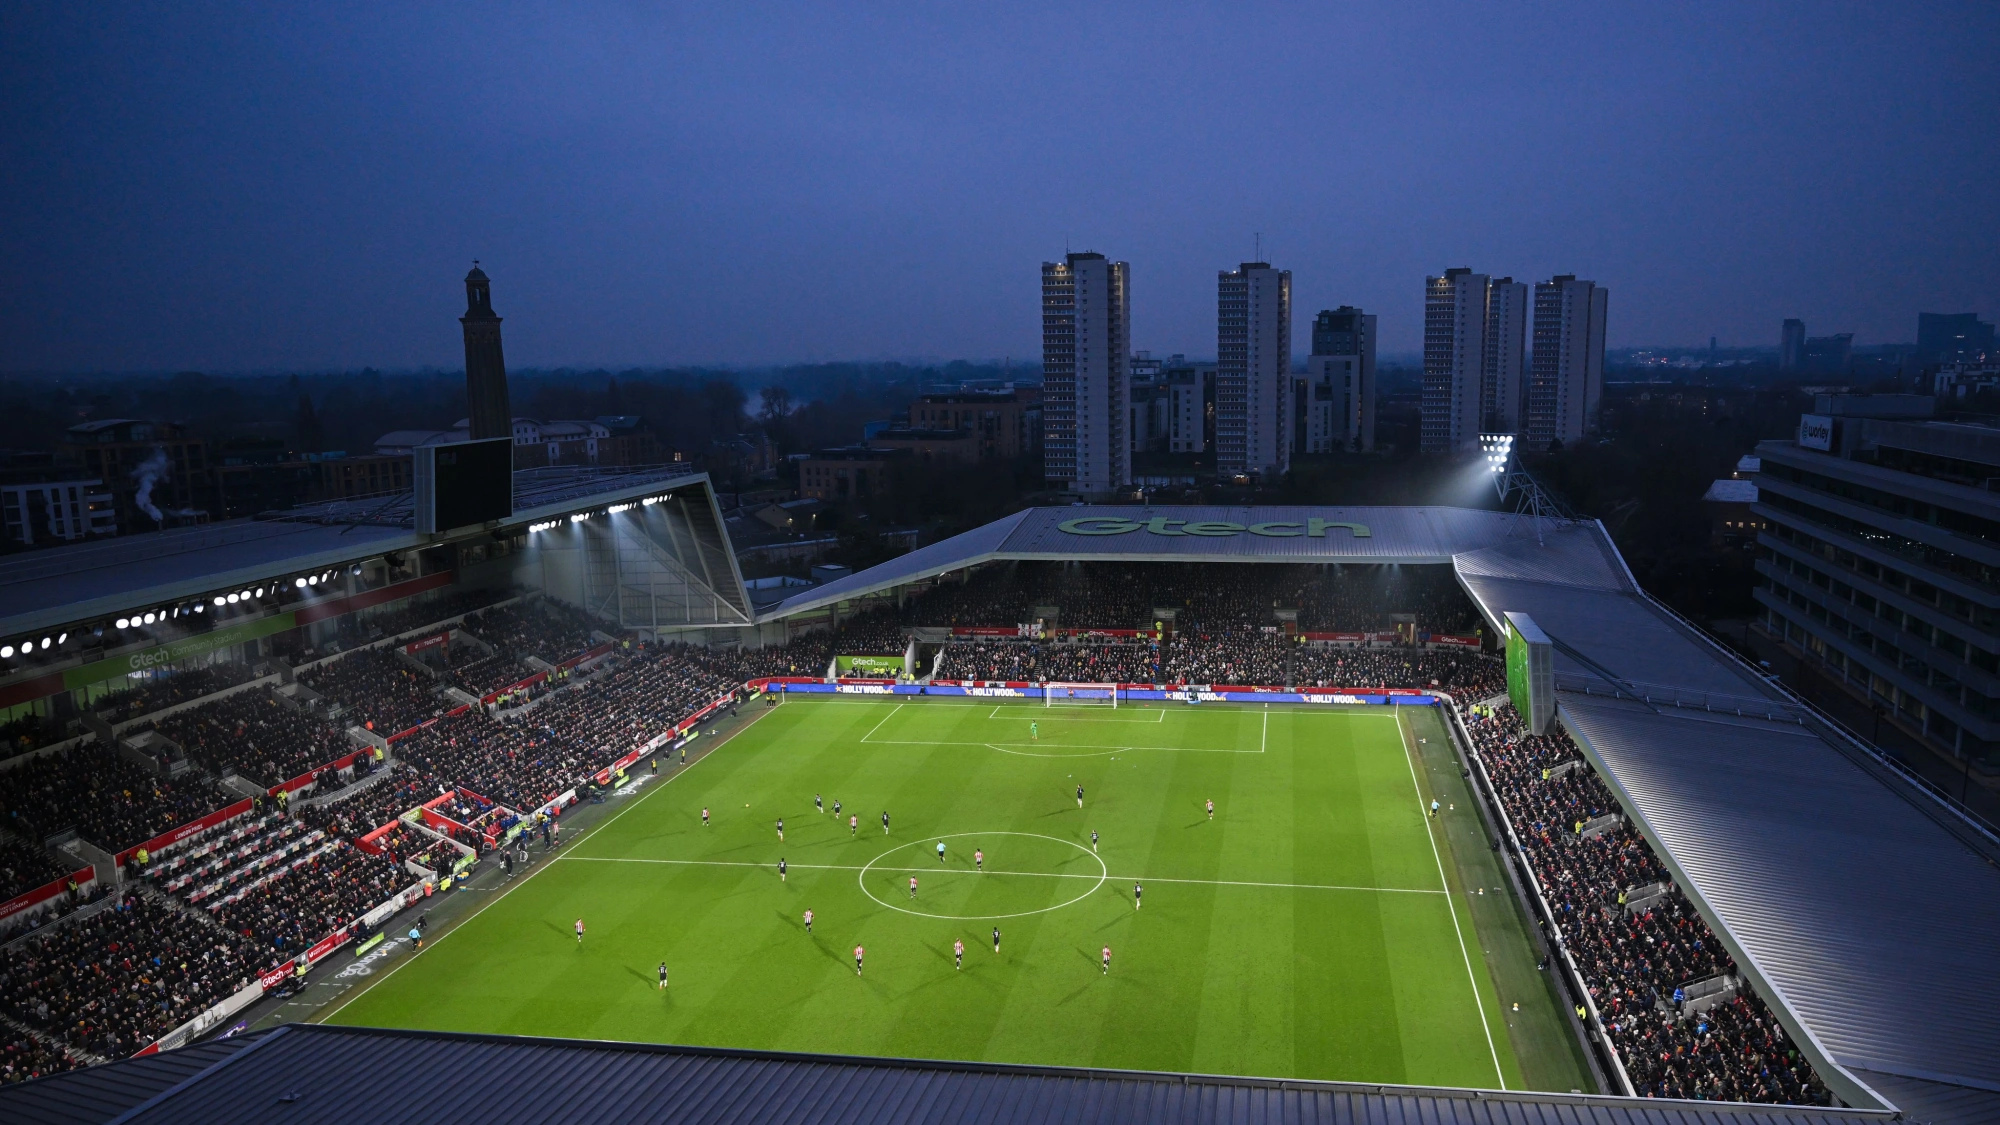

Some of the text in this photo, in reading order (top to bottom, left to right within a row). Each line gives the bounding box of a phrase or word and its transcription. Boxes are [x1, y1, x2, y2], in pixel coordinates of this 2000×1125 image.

[1809, 424, 1829, 443] worley
[1057, 517, 1371, 537] Gtech
[130, 632, 242, 669] Gtech Community Stadium
[852, 658, 889, 666] Gtech.co.uk
[174, 823, 203, 840] LONDON PRIDE
[9, 900, 29, 912] LONDON
